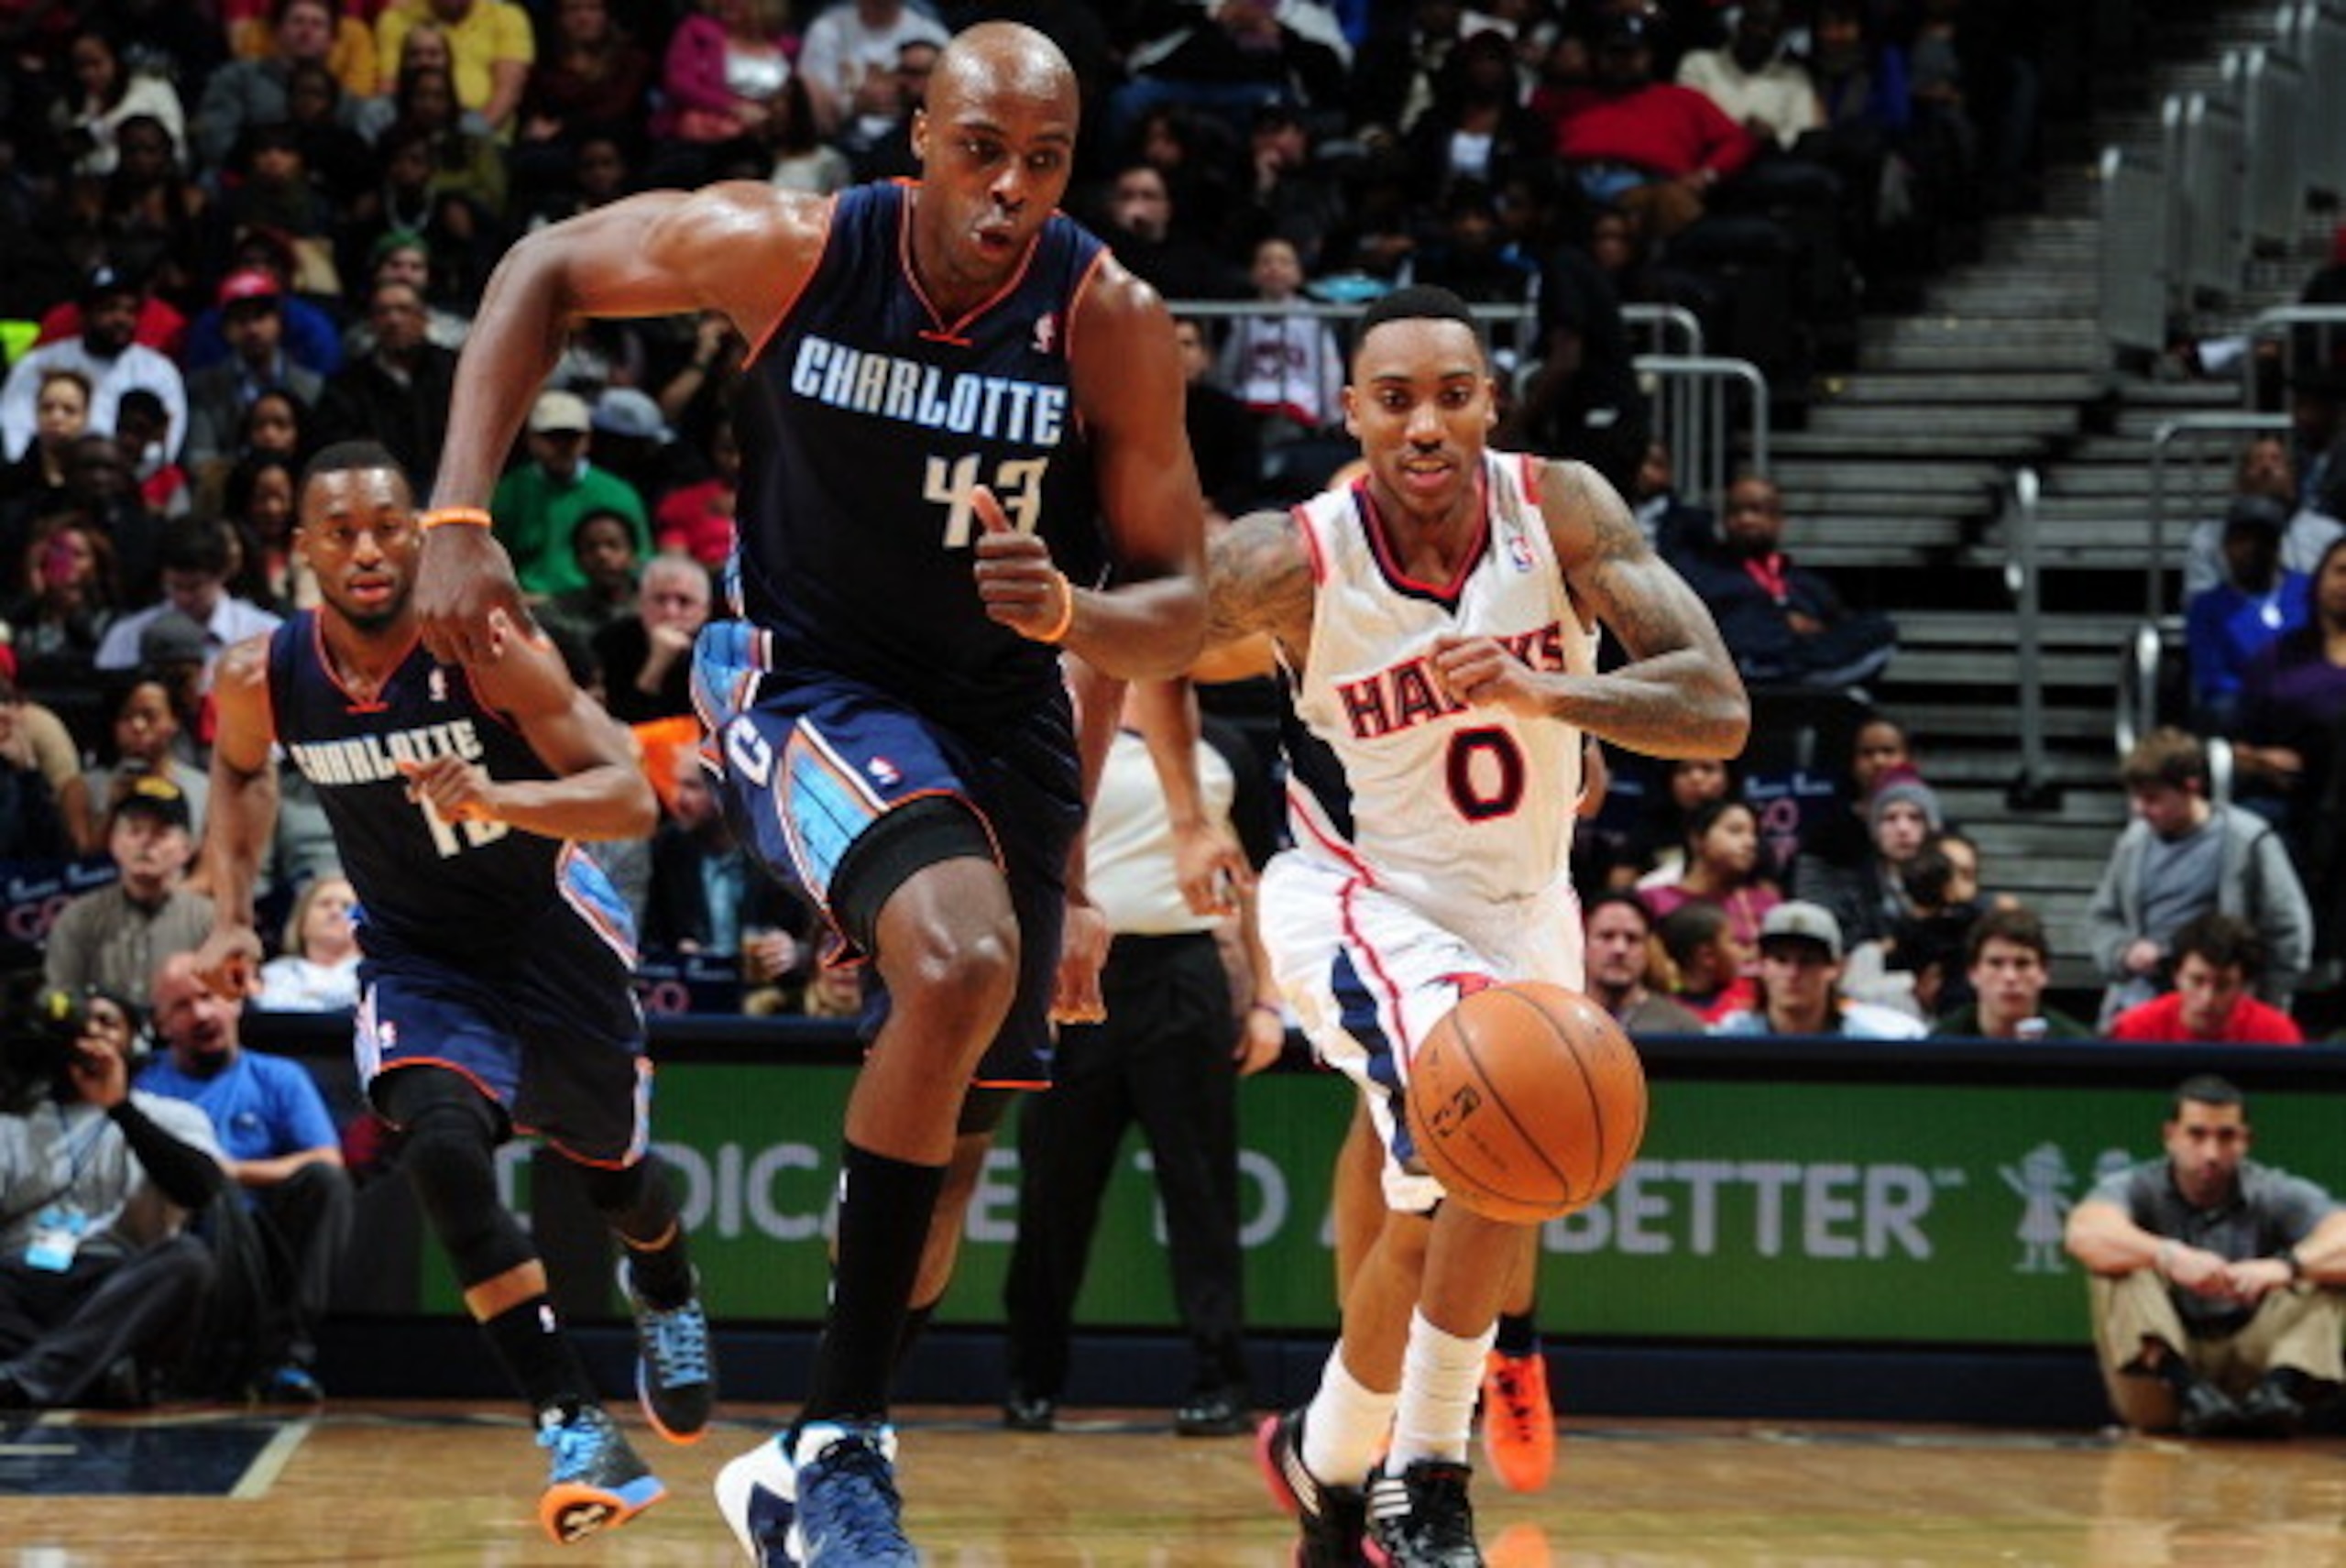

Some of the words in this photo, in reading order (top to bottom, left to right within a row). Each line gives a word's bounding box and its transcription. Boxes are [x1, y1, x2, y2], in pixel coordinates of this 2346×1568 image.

[791, 334, 1069, 446] CHARLOTTE
[923, 454, 1049, 548] 43
[1335, 620, 1566, 739] HAKS
[291, 718, 483, 784] CHARLOTTE
[726, 714, 772, 787] C
[1445, 722, 1525, 823] 0
